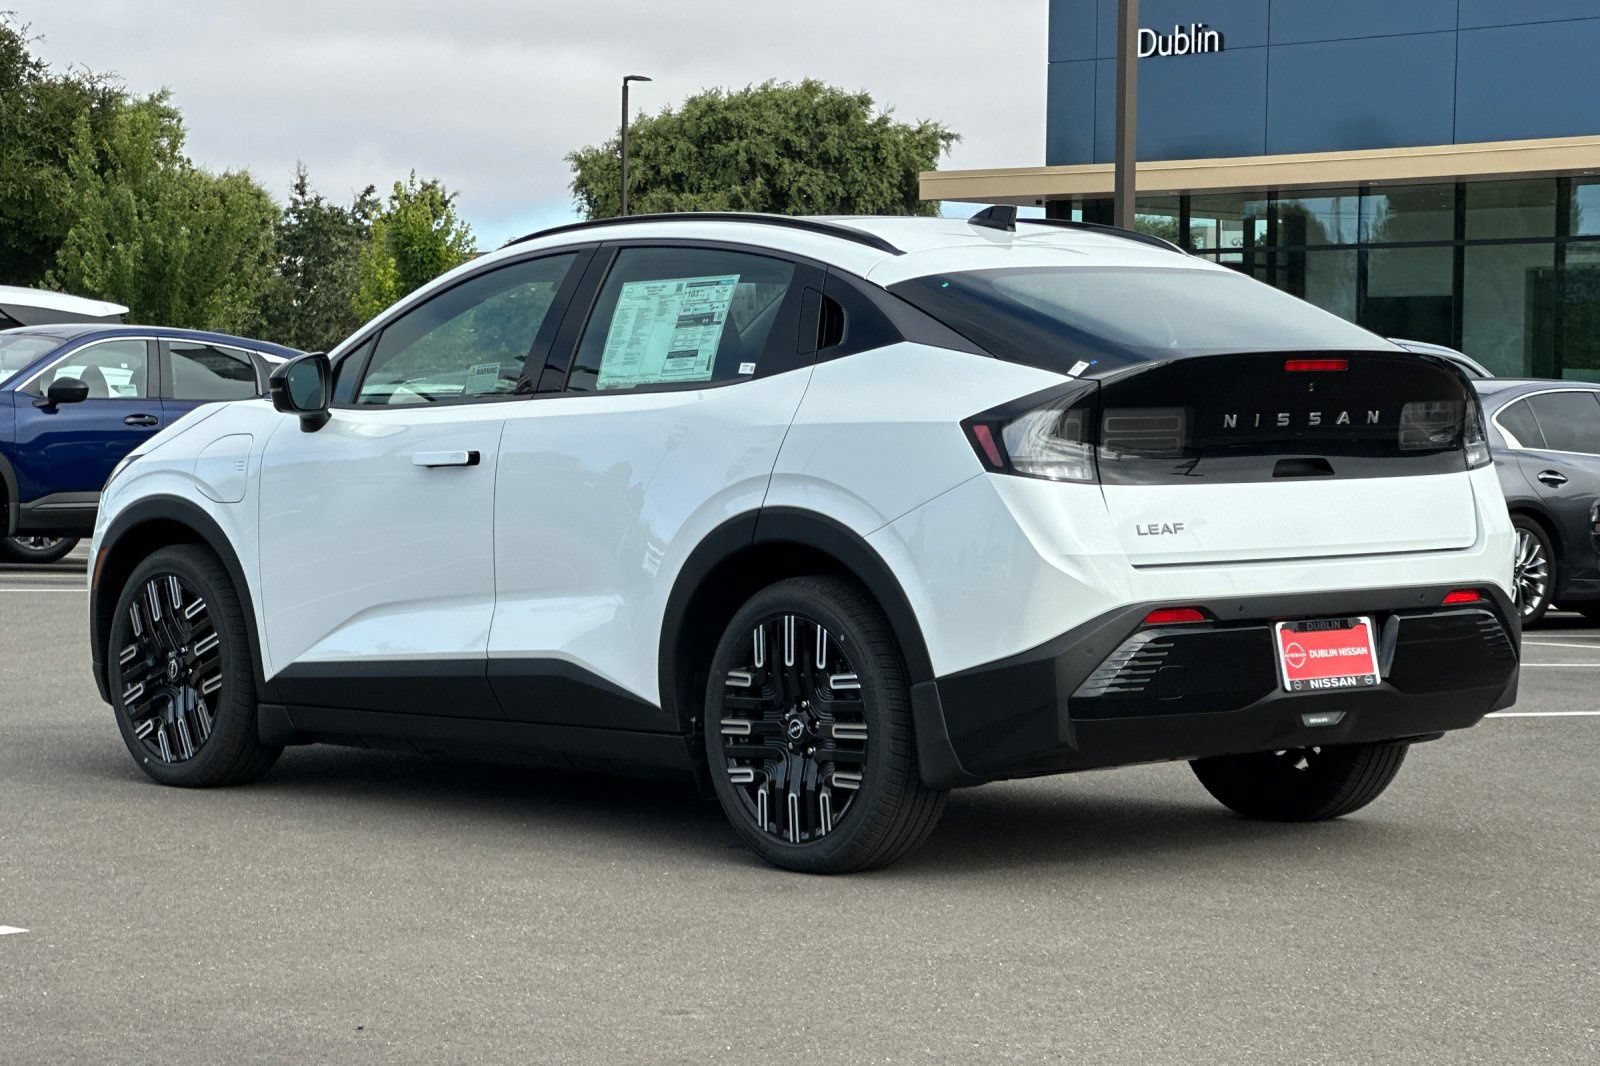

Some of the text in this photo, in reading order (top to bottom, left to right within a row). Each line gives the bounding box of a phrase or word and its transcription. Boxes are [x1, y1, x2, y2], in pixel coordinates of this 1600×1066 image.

[1137, 22, 1219, 58] Dublin
[1223, 410, 1380, 428] NISSAN
[1136, 522, 1185, 536] LEAF
[1306, 620, 1341, 631] DUBLIN
[1308, 646, 1368, 659] DUBLIN NISSAN
[1310, 677, 1357, 689] NISSAN
